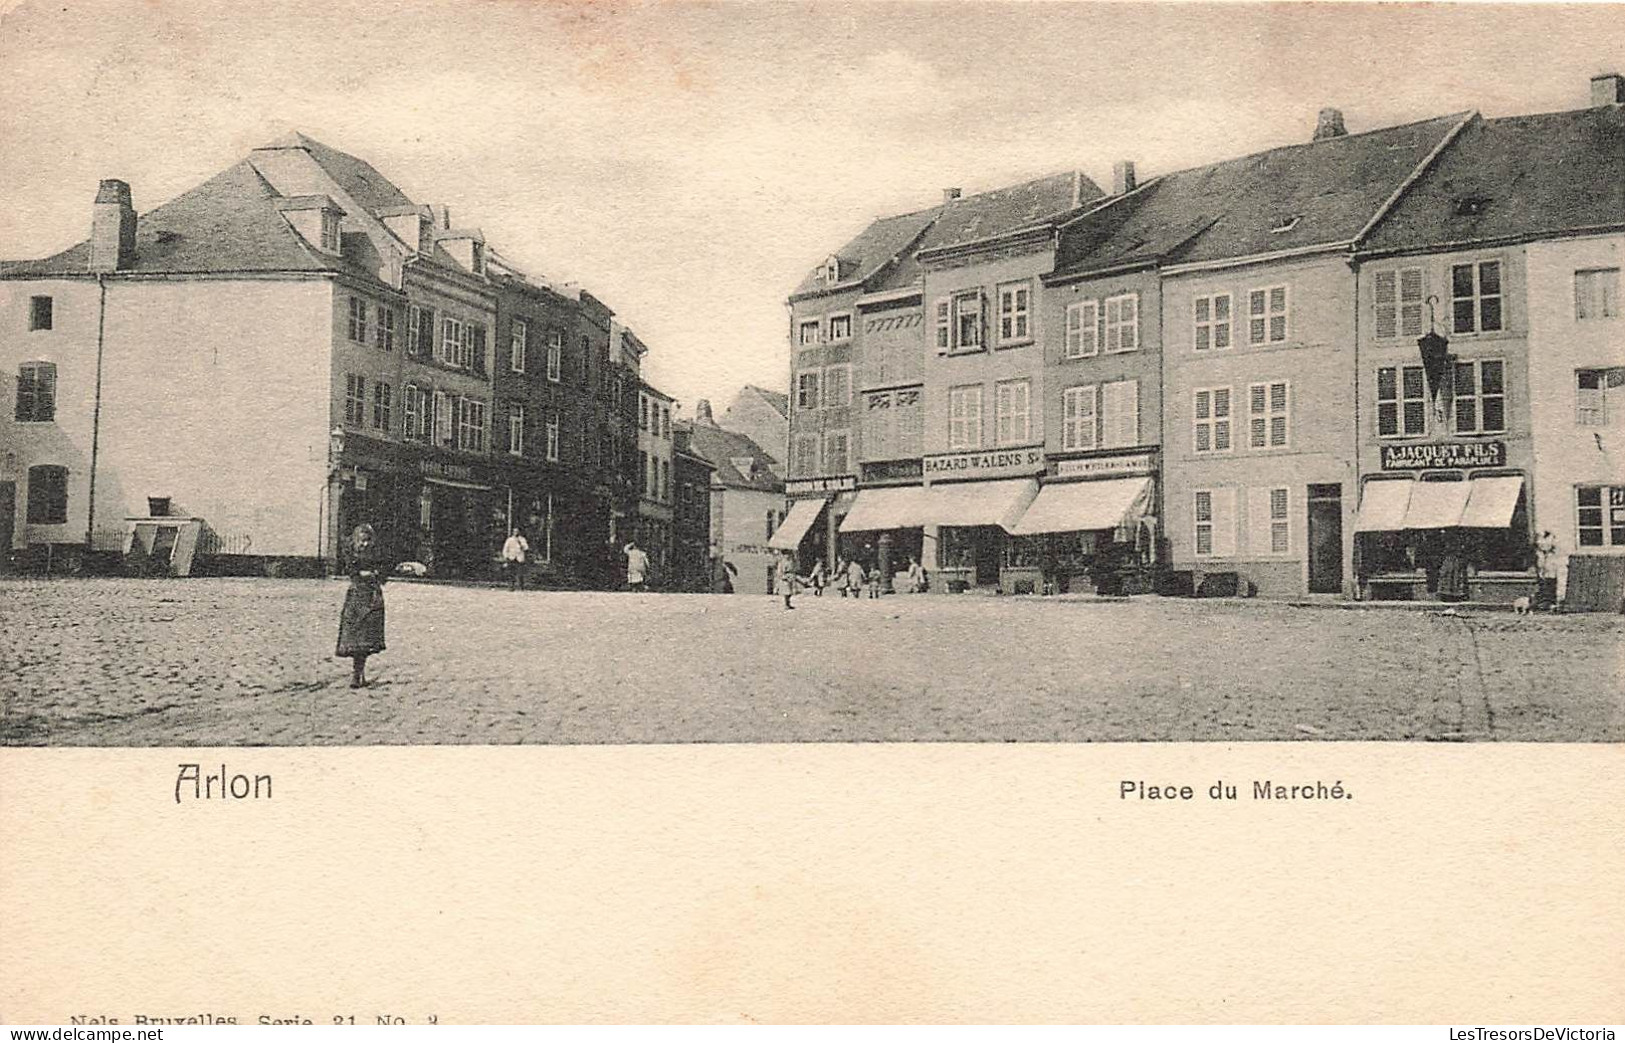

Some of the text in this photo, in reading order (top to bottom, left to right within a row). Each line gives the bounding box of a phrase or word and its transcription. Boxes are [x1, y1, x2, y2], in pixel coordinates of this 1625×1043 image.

[1464, 443, 1499, 457] FILS
[925, 458, 968, 472] BAZARD
[971, 453, 1022, 469] WALENS
[175, 763, 272, 804] Arlon
[1120, 780, 1353, 800] Place du Marché.
